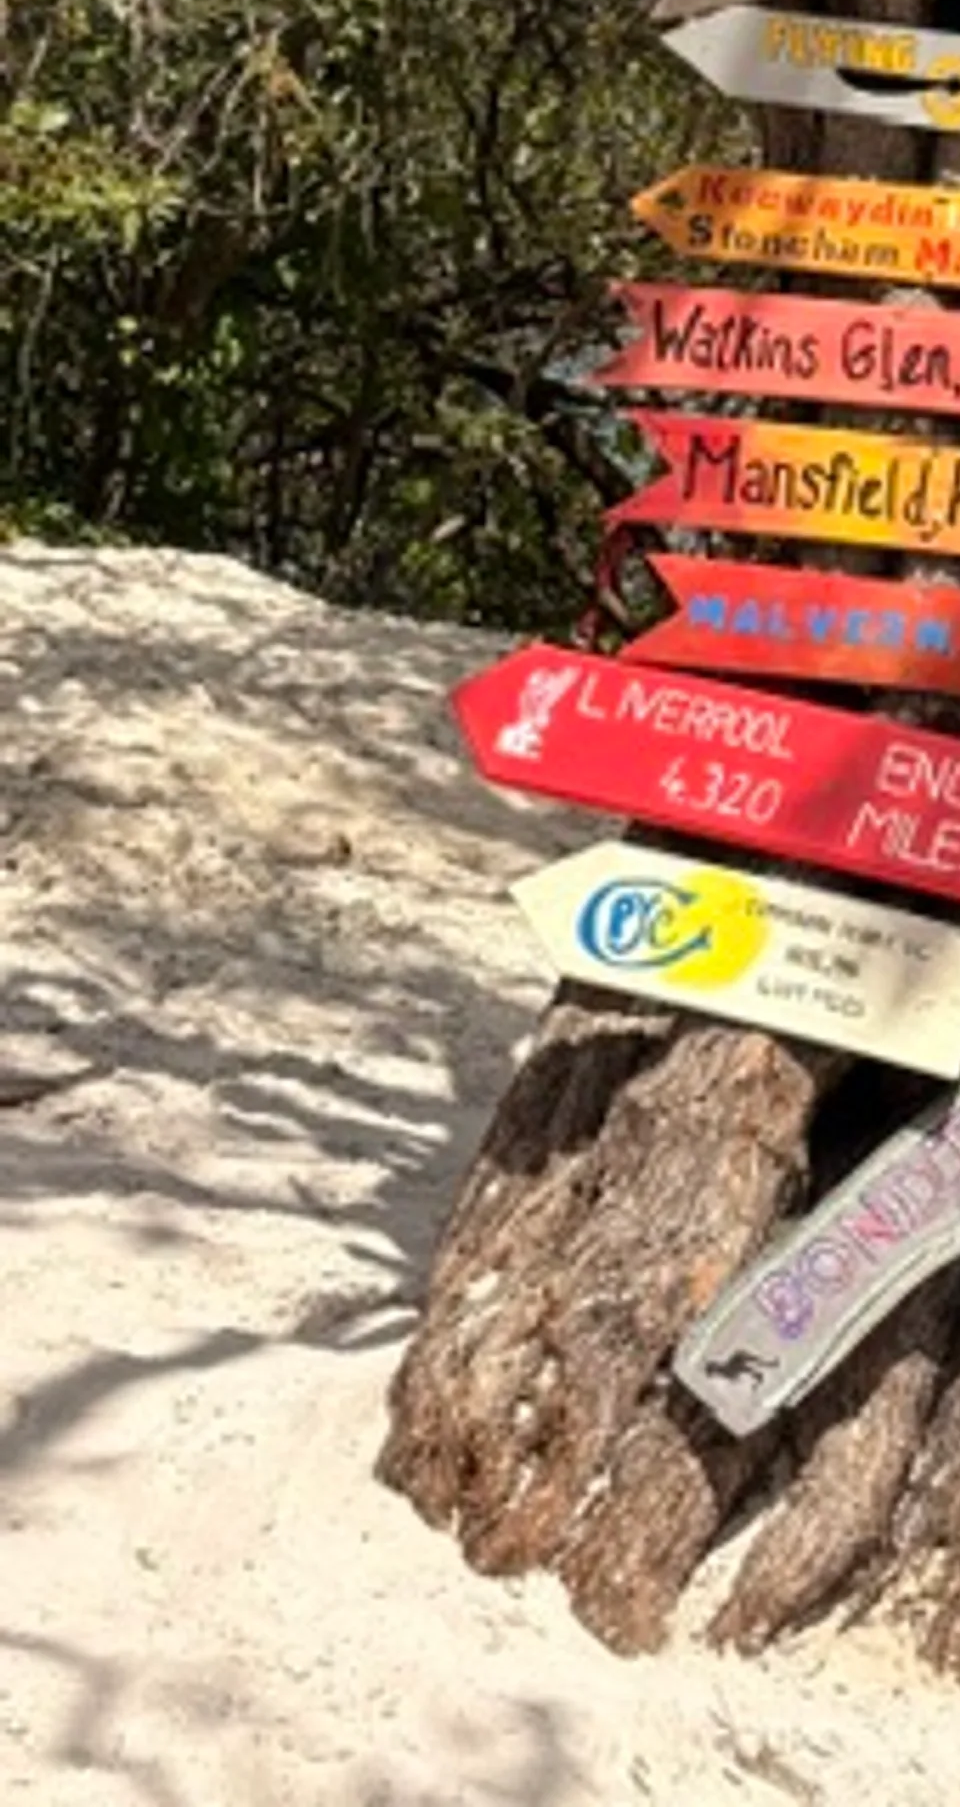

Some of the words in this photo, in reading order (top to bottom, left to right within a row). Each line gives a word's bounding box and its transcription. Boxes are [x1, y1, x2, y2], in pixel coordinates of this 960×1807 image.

[698, 174, 936, 229] Keewaydin
[650, 299, 819, 379] Watkins
[576, 671, 796, 761] LIVERPOOL
